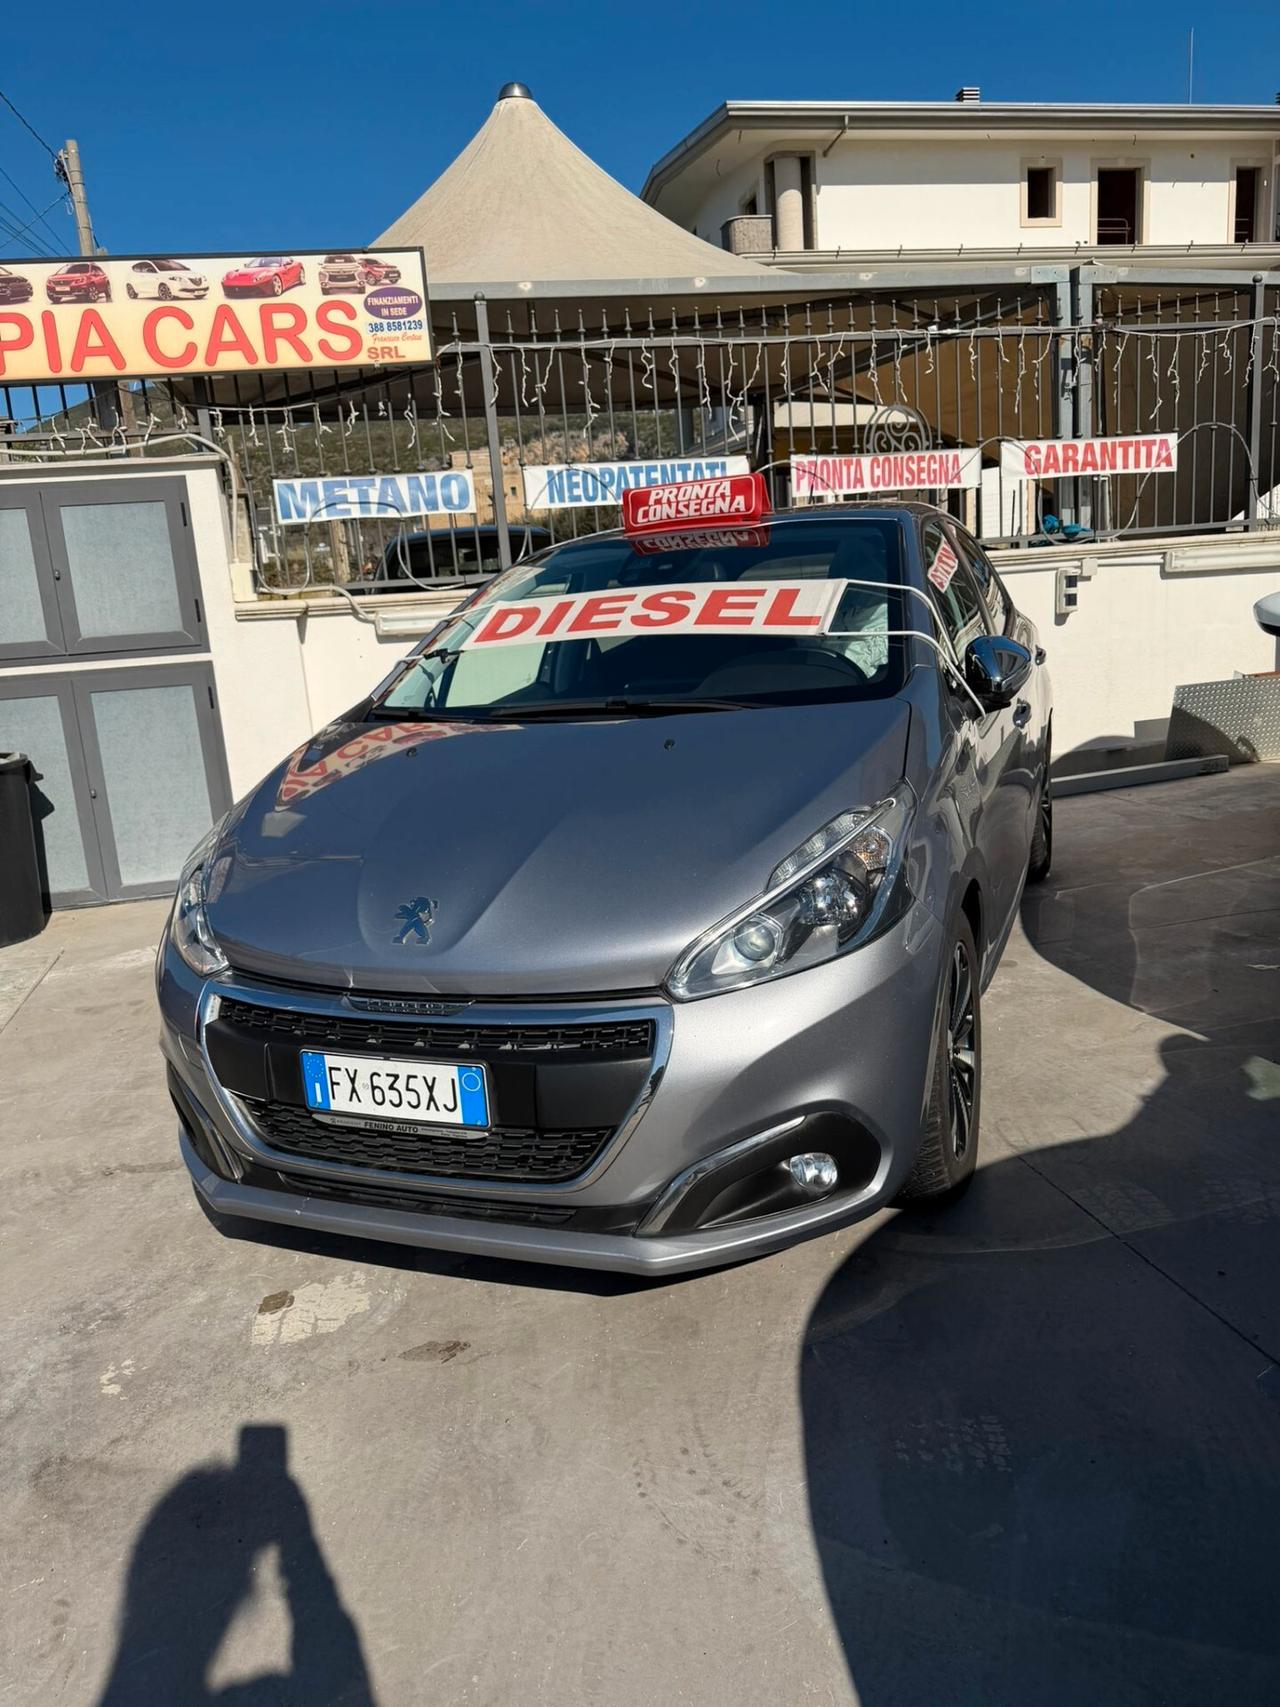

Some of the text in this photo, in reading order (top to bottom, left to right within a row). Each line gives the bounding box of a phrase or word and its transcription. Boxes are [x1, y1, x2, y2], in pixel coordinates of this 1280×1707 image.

[367, 296, 418, 305] FINANZIAMENTI
[381, 307, 408, 316] IN SEDE
[142, 299, 364, 369] CARS
[368, 320, 422, 333] 388 8581239
[367, 346, 406, 360] SRL
[1024, 437, 1173, 476] GARANTITA
[795, 452, 963, 493] PRONTA CONSEGNA
[277, 471, 470, 521] METANO
[648, 480, 732, 506] PRONTA
[636, 495, 746, 524] CONSEGNA
[473, 588, 823, 644] DIESEL
[328, 1065, 363, 1104] FX
[369, 1071, 459, 1113] 635XJ
[364, 1120, 395, 1131] FENINO
[395, 1123, 419, 1133] AUTO
